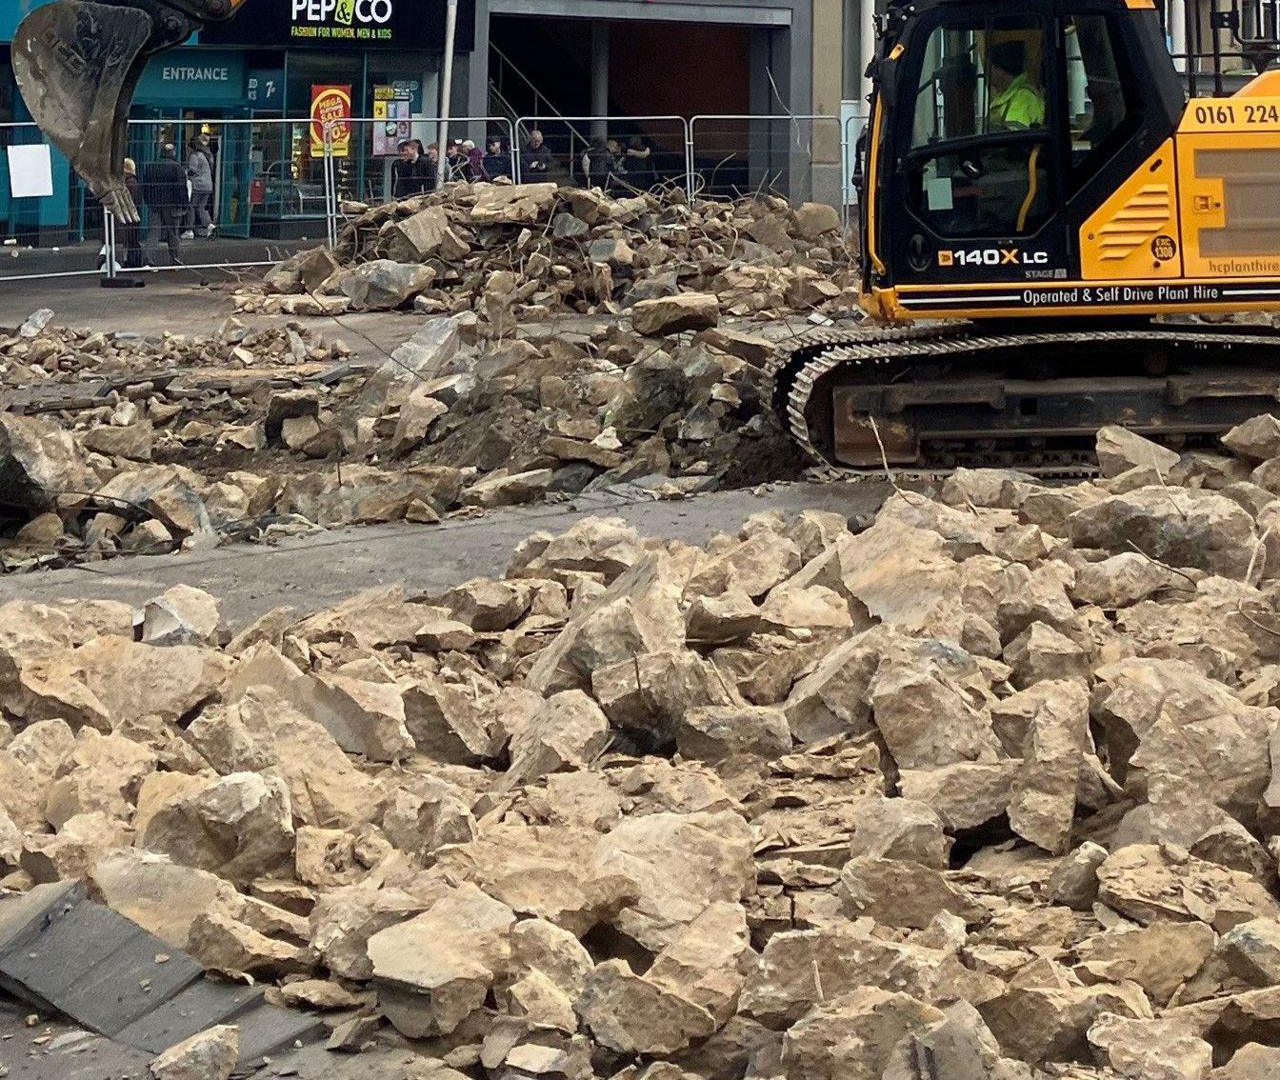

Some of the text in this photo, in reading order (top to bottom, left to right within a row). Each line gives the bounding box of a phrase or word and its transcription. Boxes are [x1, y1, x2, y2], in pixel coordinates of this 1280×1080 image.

[318, 27, 330, 37] FOR
[163, 67, 228, 80] ENTRANCE
[1195, 106, 1235, 124] 0161
[1244, 105, 1279, 123] 224
[954, 248, 1020, 265] 140X
[1023, 251, 1048, 264] LC
[1025, 270, 1054, 279] STAGE
[1023, 285, 1219, 306] Operated & Self Drive Plant Hire
